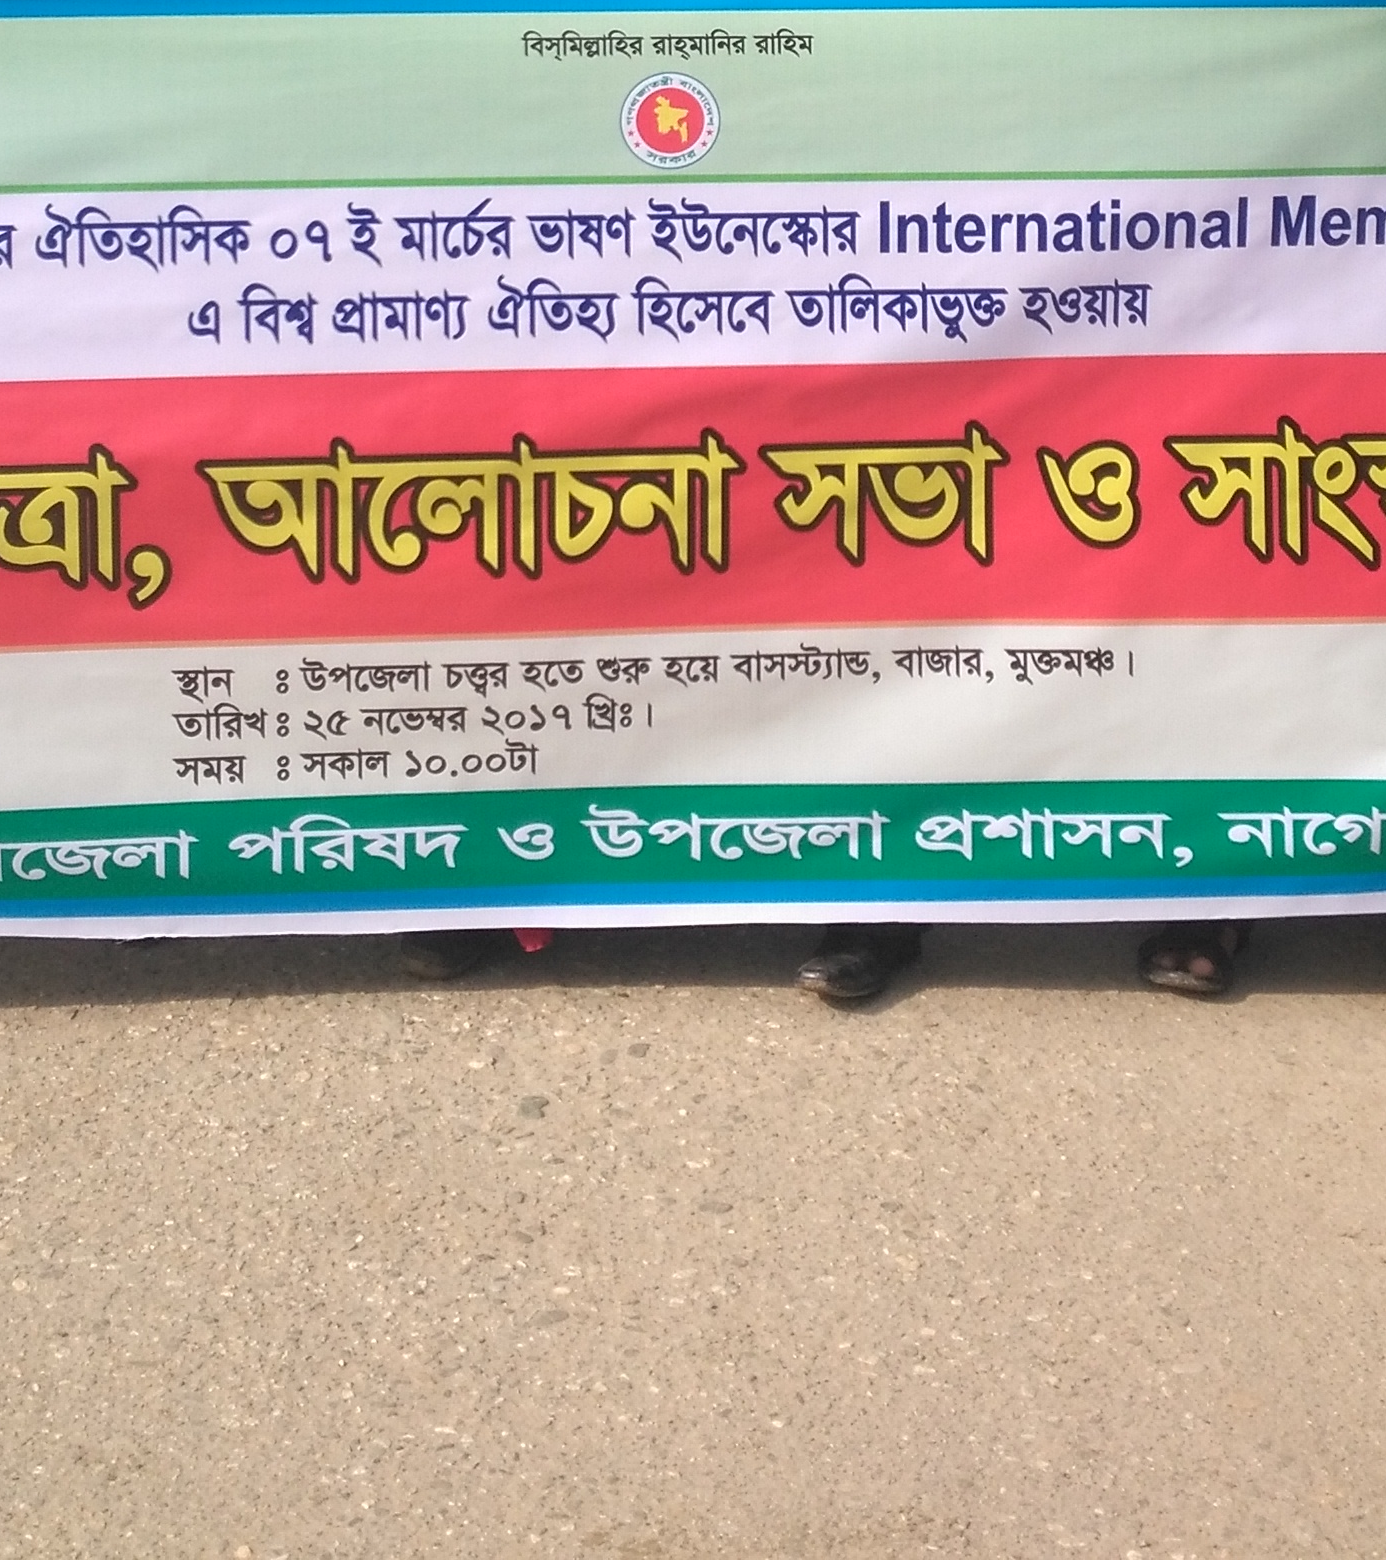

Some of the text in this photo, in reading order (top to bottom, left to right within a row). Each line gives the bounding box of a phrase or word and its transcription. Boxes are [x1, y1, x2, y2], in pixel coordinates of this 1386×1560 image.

[753, 28, 814, 57] রাহিম
[35, 203, 252, 271] ঐতিহাসিক
[270, 223, 332, 262] ০৭
[346, 202, 382, 266] ই
[393, 198, 515, 261] মার্চের
[526, 207, 636, 259] ভাষণ
[646, 197, 861, 263] ইউনেস্কোর
[879, 196, 1249, 254] International
[188, 273, 1153, 345] এ বিশ্ব প্রামাণ্য ঐতিহ্য হিসেবে তালিকাভুক্ত হওয়ায়
[196, 427, 747, 583] আলোচনা
[758, 420, 1010, 566] সভা
[1036, 440, 1141, 549] ও
[171, 665, 235, 704] স্থান
[298, 657, 432, 693] উপজেলা
[519, 659, 585, 692] হতে
[596, 657, 652, 685] শুরু
[661, 655, 720, 687] হয়ে
[891, 644, 994, 684] বাজার,
[1004, 646, 1114, 685] মুক্তমঞ্চ
[171, 702, 269, 741] তারিখ
[303, 710, 351, 741] ২৫
[359, 706, 468, 736] নভেম্বর
[481, 704, 572, 736] ২০১৭
[172, 755, 247, 786] সময়
[299, 748, 392, 780] সকাল
[405, 738, 539, 778] ১০.০০টা
[228, 813, 469, 874] পরিষদ
[497, 822, 555, 860] ও
[580, 803, 890, 861] উপজেলা
[915, 807, 1194, 868] প্রশাসন,
